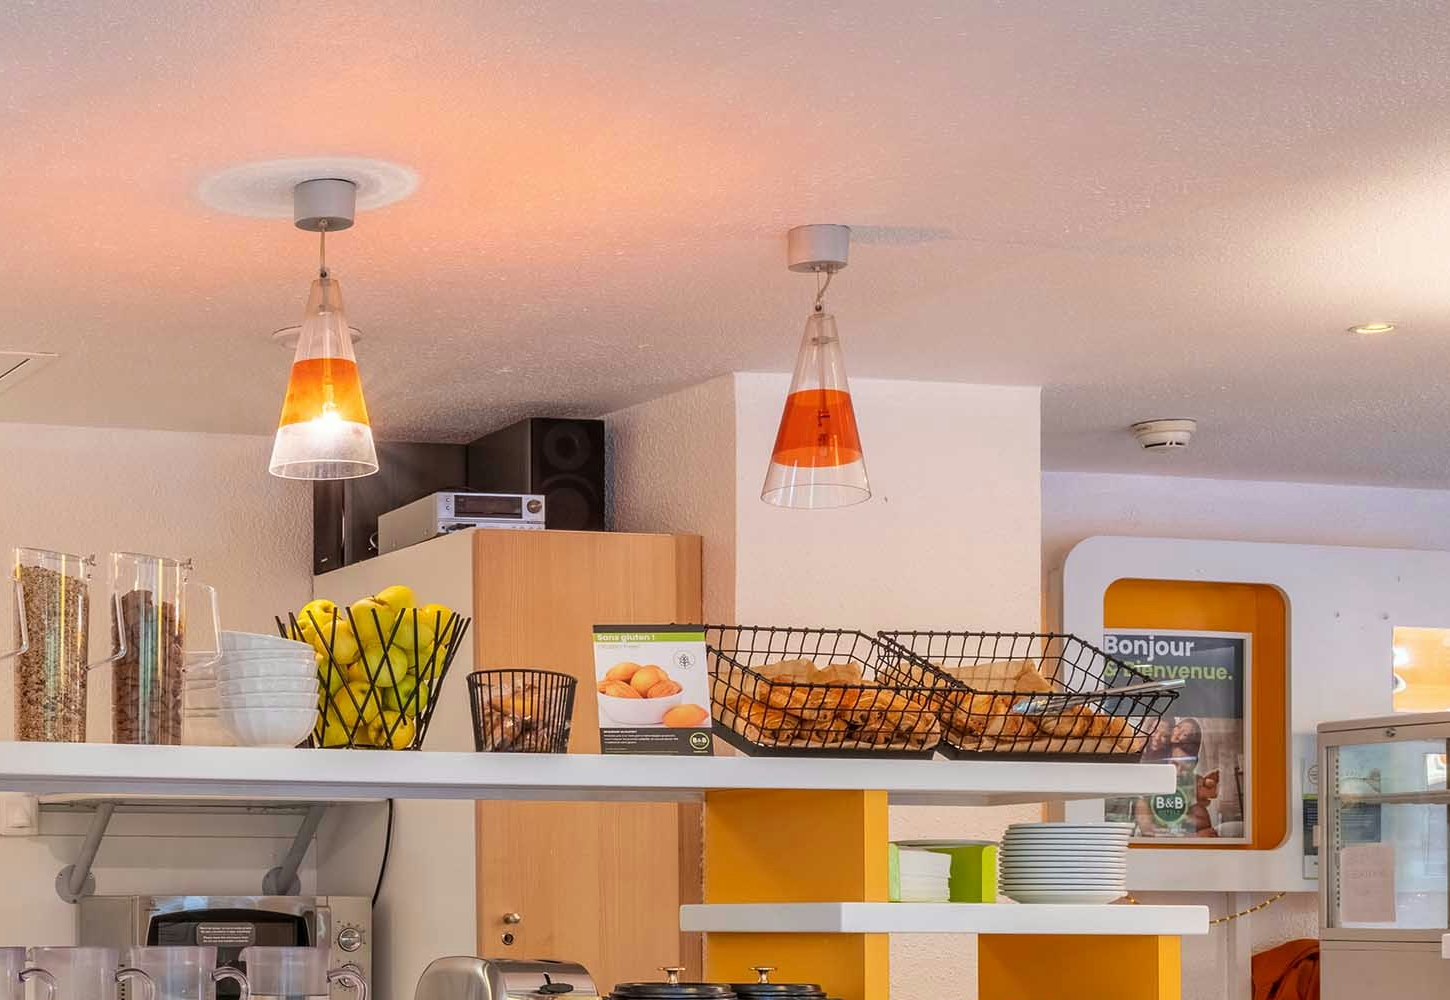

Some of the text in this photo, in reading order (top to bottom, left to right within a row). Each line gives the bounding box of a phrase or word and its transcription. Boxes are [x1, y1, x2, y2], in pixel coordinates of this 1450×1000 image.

[598, 633, 620, 641] Sans
[621, 633, 650, 643] gluten
[1104, 636, 1195, 662] Bonjour
[1156, 796, 1184, 810] B&B
